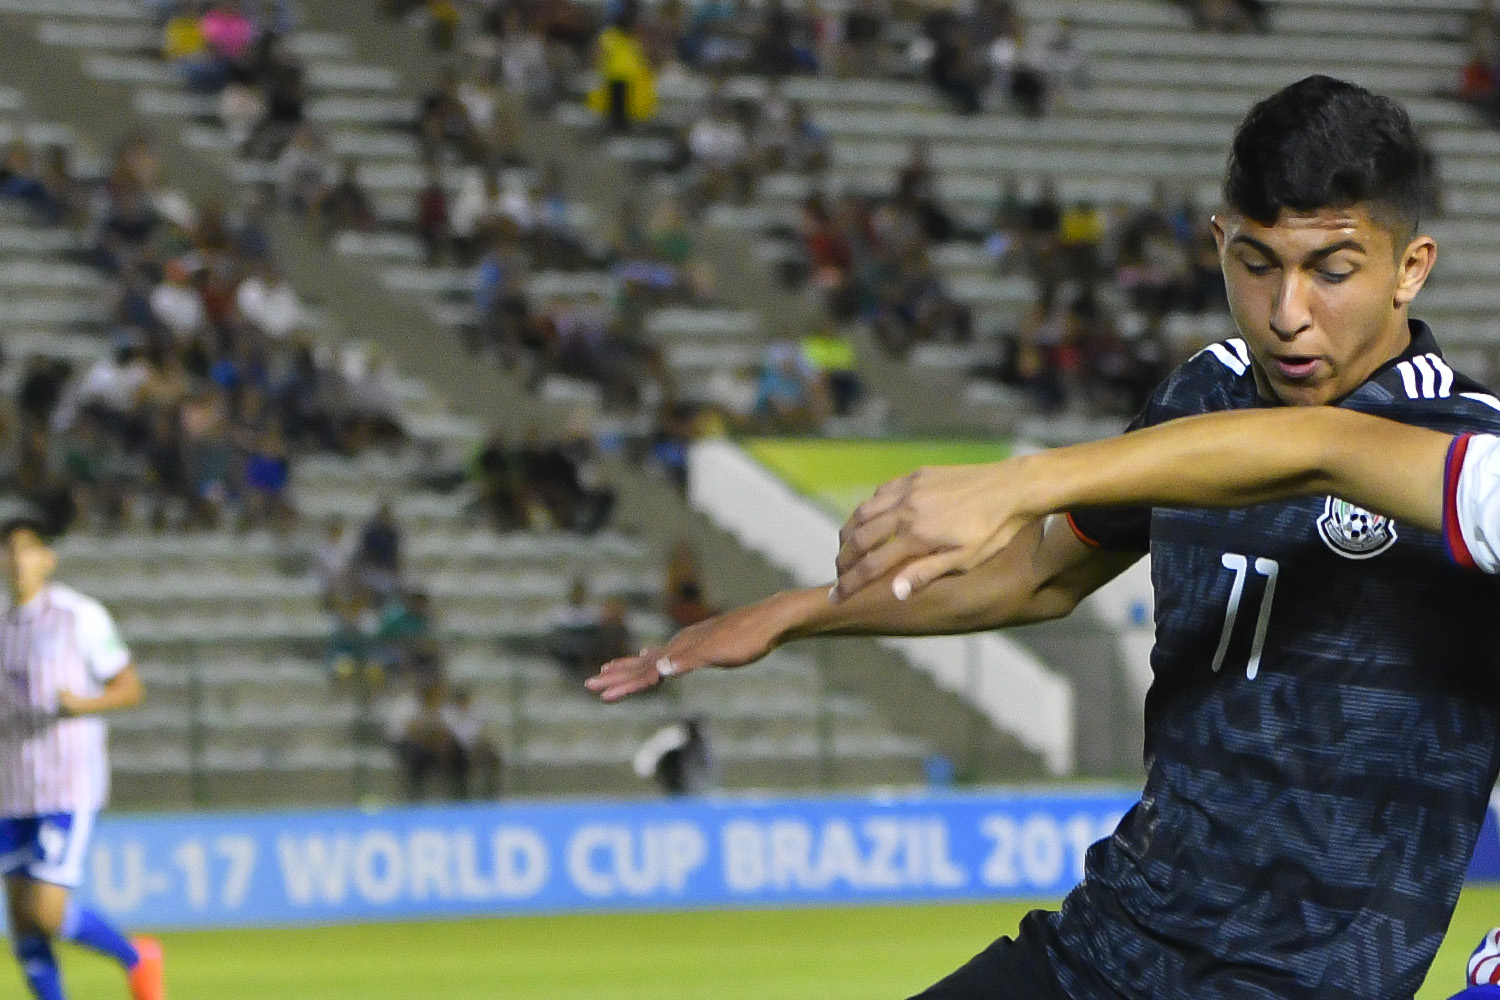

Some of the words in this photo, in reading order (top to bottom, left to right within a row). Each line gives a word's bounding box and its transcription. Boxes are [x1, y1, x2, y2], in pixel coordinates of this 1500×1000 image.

[92, 834, 256, 913] U-17
[279, 826, 549, 904] WORLD
[567, 822, 707, 895] CUP
[721, 814, 966, 890] BRAZIL
[978, 809, 1126, 888] 201
